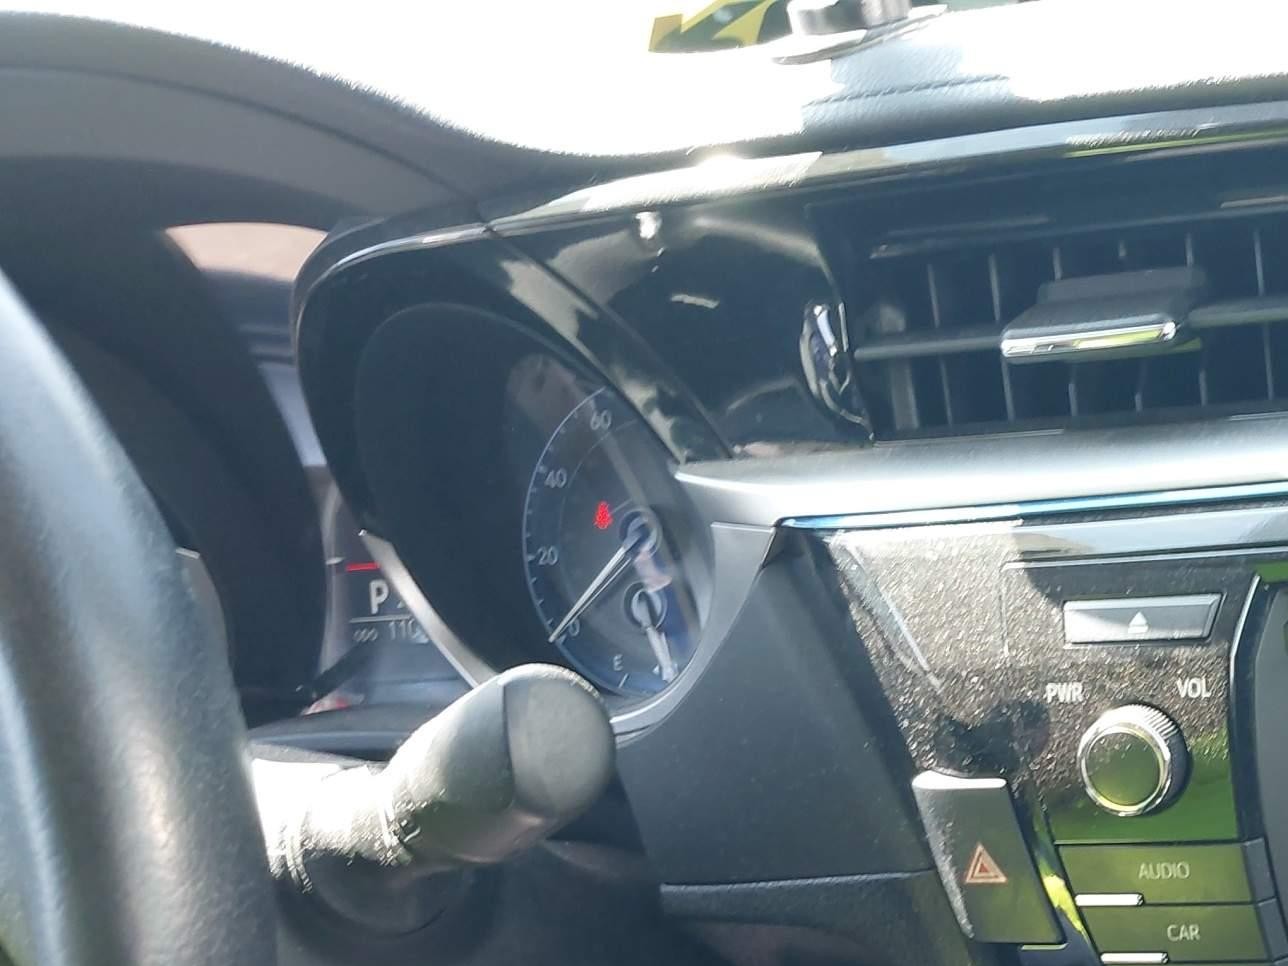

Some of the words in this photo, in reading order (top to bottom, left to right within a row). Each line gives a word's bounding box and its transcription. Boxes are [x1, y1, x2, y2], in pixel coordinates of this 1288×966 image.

[589, 409, 612, 431] 60
[545, 468, 567, 489] 40
[537, 546, 558, 566] 20
[369, 579, 389, 615] P
[612, 653, 624, 672] E
[1045, 681, 1085, 702] PWR
[1176, 676, 1212, 698] VOL
[1138, 861, 1191, 880] AUDIO
[1166, 923, 1201, 942] CAR
